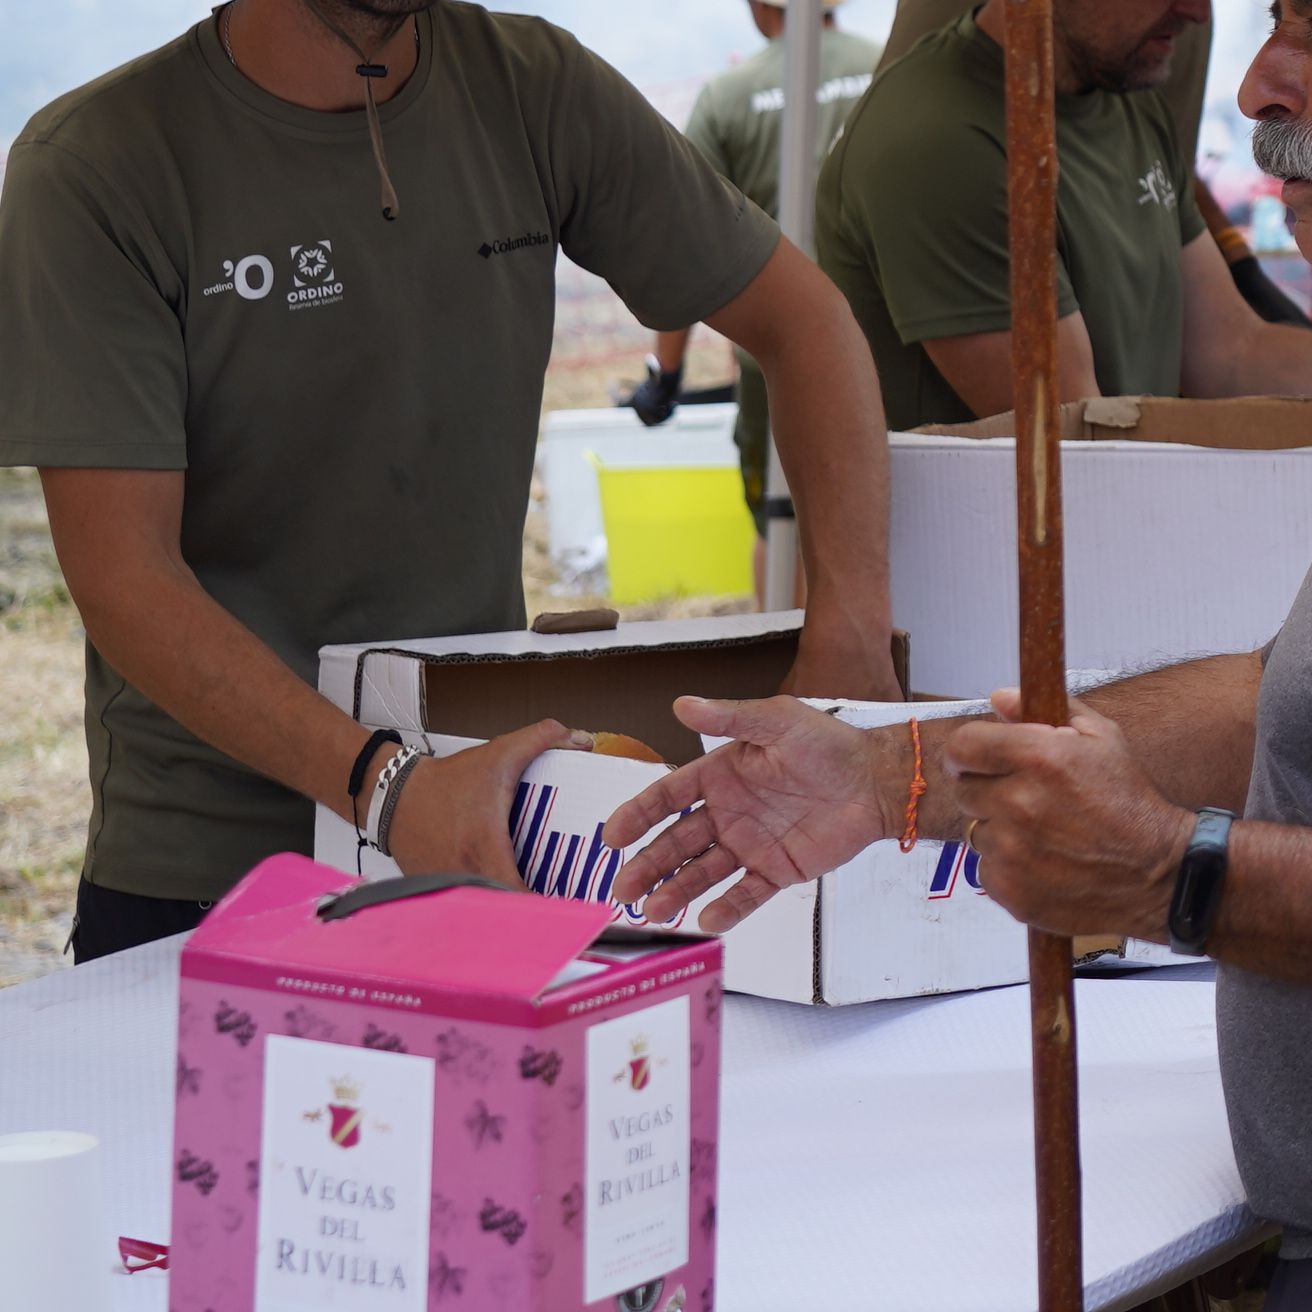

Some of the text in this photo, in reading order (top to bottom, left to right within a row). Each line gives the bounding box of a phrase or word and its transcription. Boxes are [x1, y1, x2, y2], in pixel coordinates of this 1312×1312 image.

[493, 231, 549, 255] Columbia
[203, 281, 234, 296] ordino
[287, 282, 344, 303] ORDINO
[609, 1103, 674, 1140] VEGAS
[627, 1142, 656, 1165] DEL
[296, 1165, 397, 1211] VEGAS
[600, 1160, 681, 1207] RIVILLA
[318, 1214, 367, 1242] DEL
[275, 1238, 407, 1291] RIVILLA
